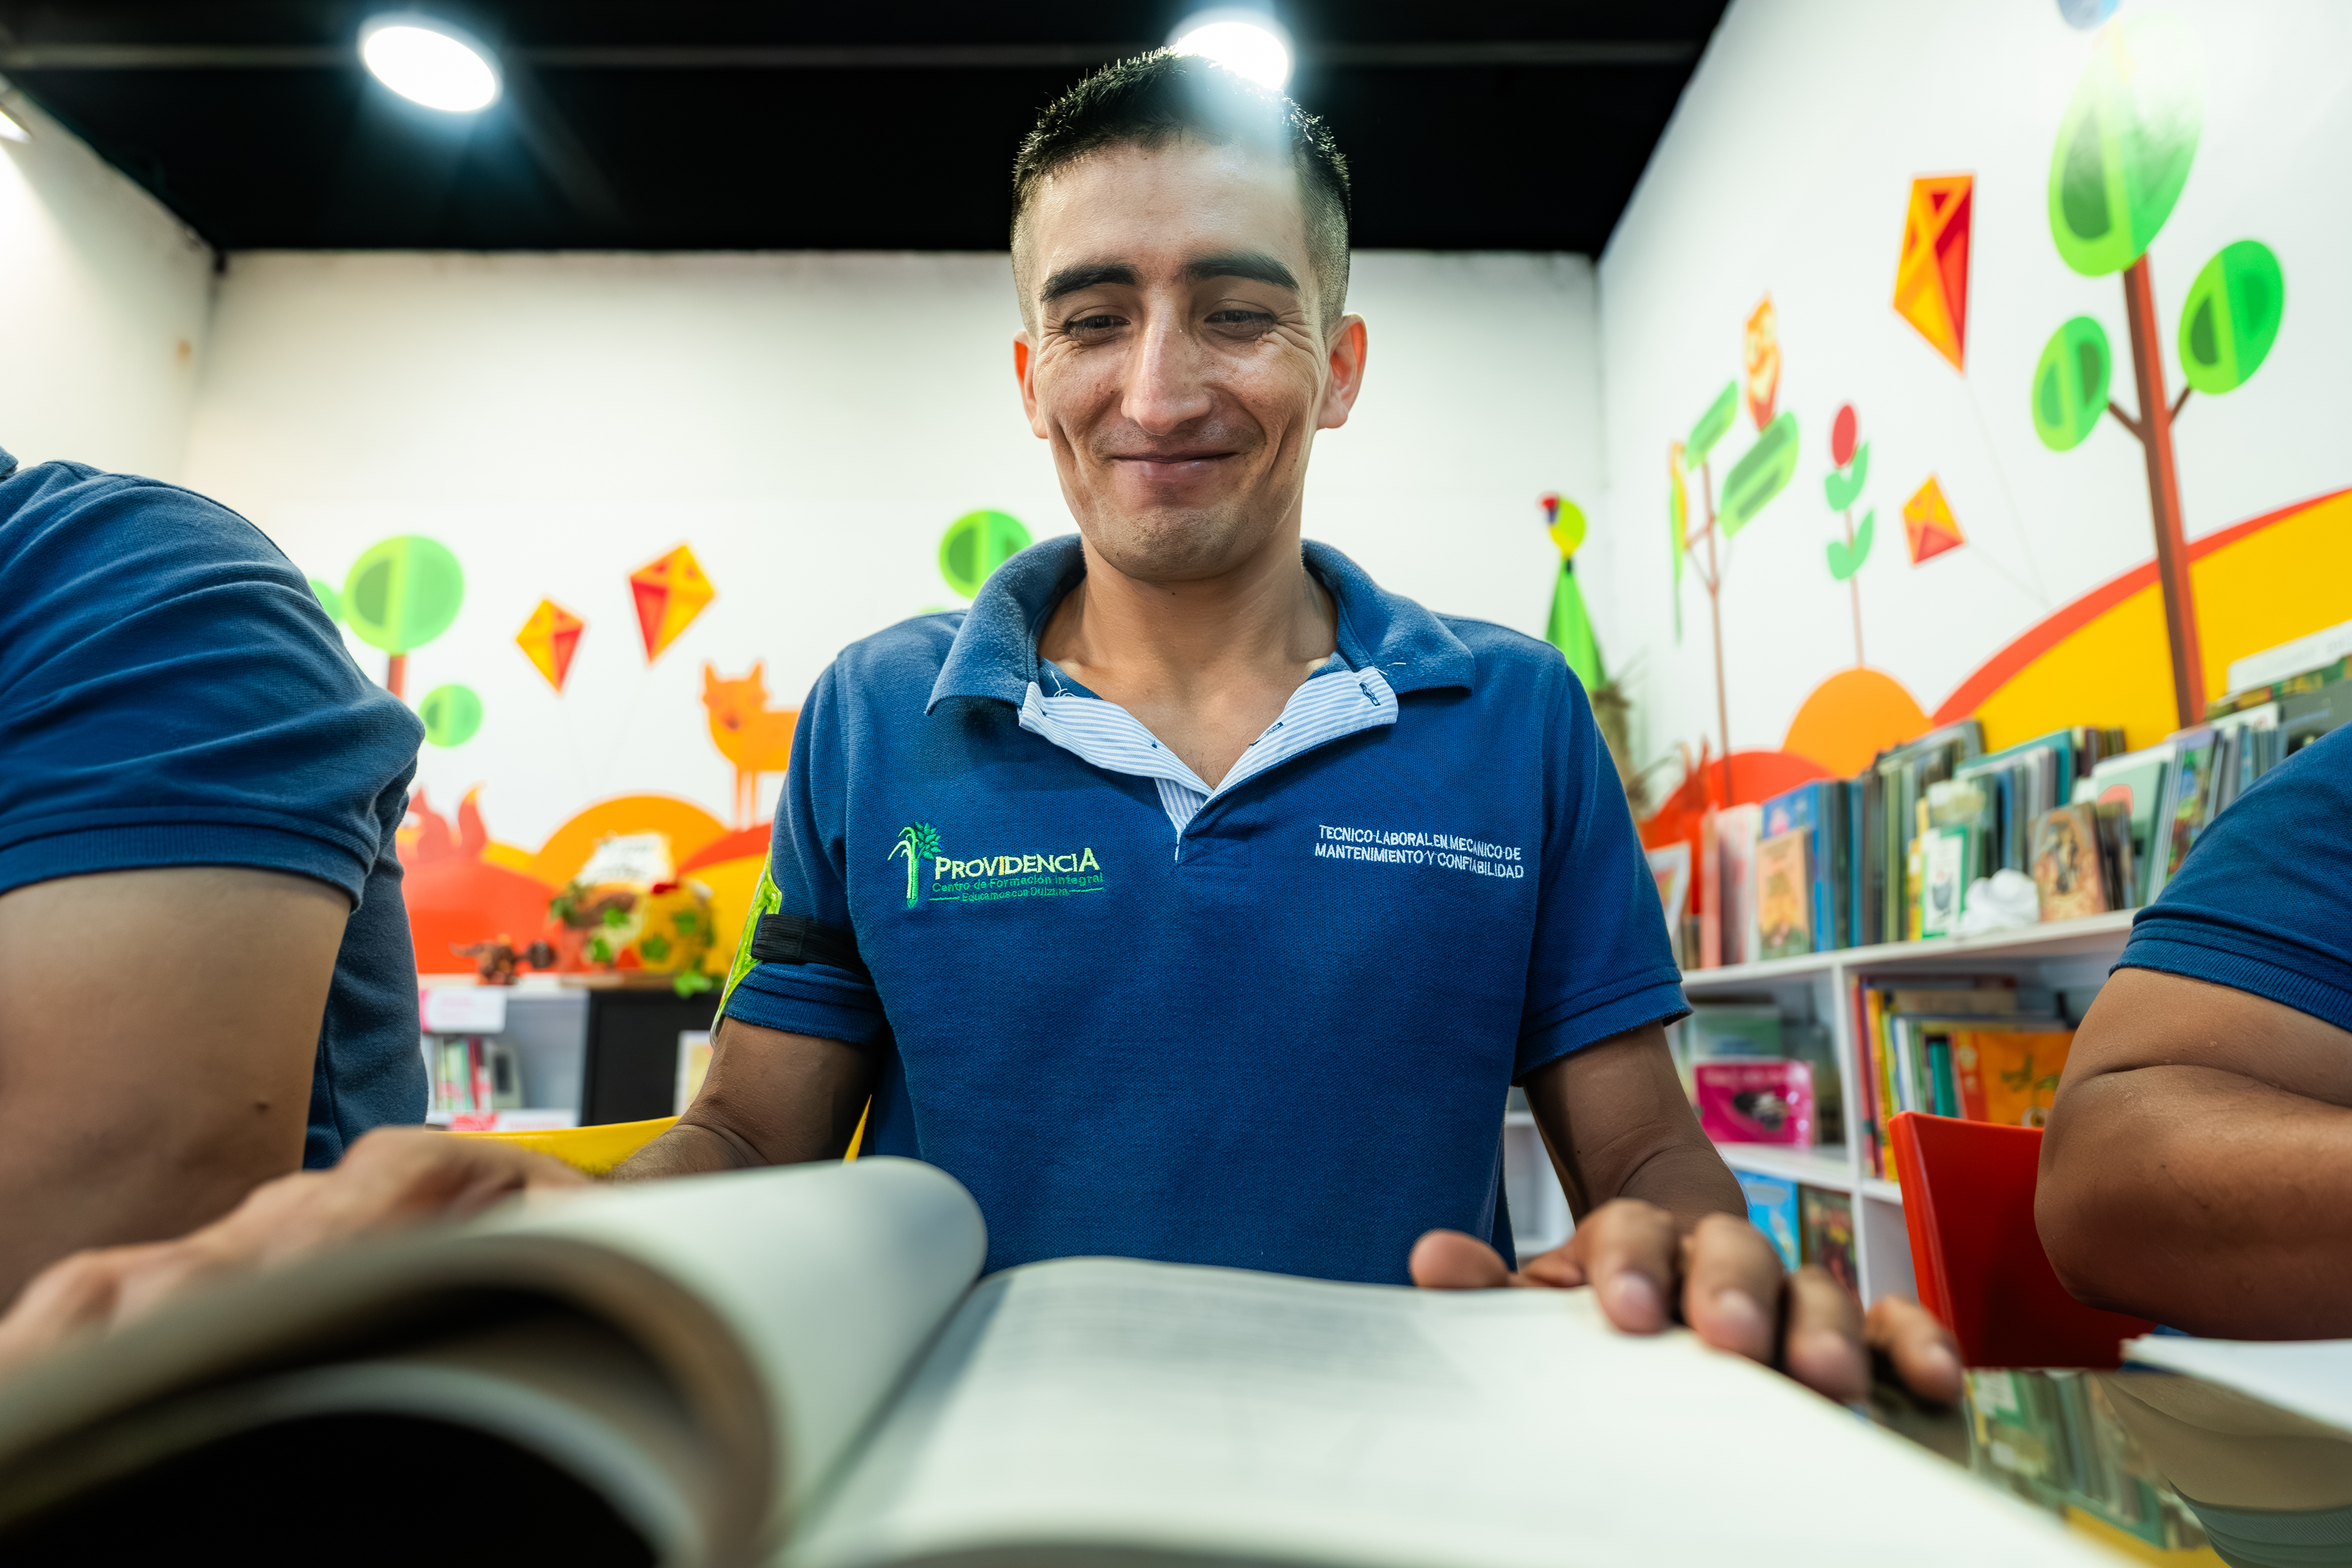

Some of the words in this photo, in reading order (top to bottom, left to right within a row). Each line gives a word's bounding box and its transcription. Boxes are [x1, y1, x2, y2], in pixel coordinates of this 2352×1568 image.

[1319, 824, 1373, 843] TECNICO
[1376, 830, 1433, 846] LABORAL
[1433, 834, 1448, 850] EN
[1449, 834, 1502, 859] MECANICO
[1505, 846, 1521, 861] DE
[935, 847, 1101, 880] PROVIDENCIA
[1314, 843, 1424, 864] MANTENIMIENTO
[1425, 850, 1435, 865] Y
[1437, 852, 1524, 878] CONFIABILIDAD
[932, 881, 970, 892] Centro
[973, 879, 987, 889] de
[1055, 872, 1104, 886] Integral
[962, 891, 1011, 902] Educamos
[1011, 889, 1028, 897] con
